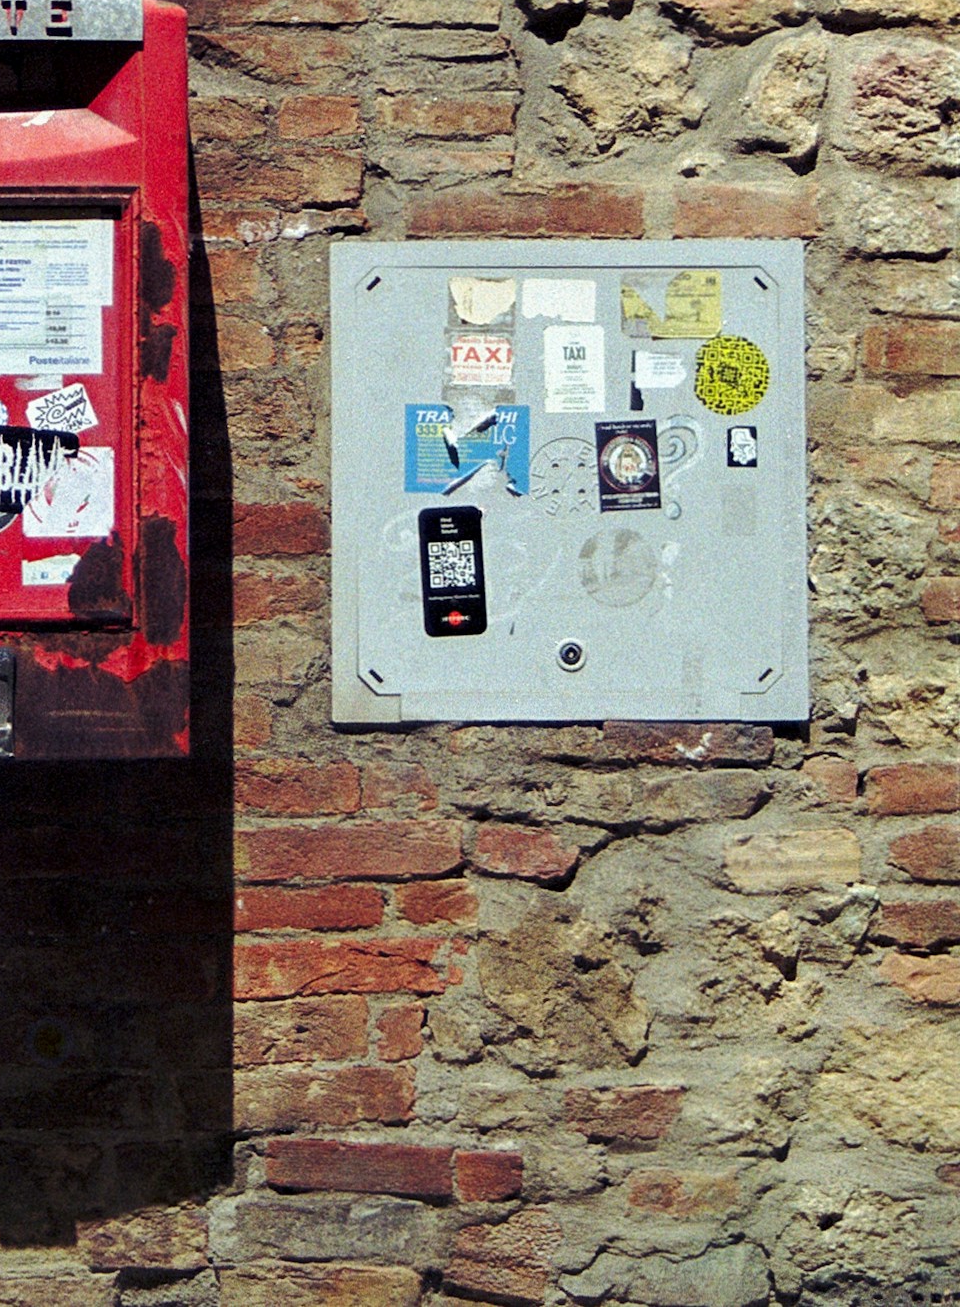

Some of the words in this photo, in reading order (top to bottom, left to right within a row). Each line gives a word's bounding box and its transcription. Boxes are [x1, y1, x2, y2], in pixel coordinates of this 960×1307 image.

[28, 355, 91, 365] Posteitaliane
[451, 345, 513, 364] TAXI
[562, 346, 587, 361] TAXI
[492, 424, 518, 445] LG
